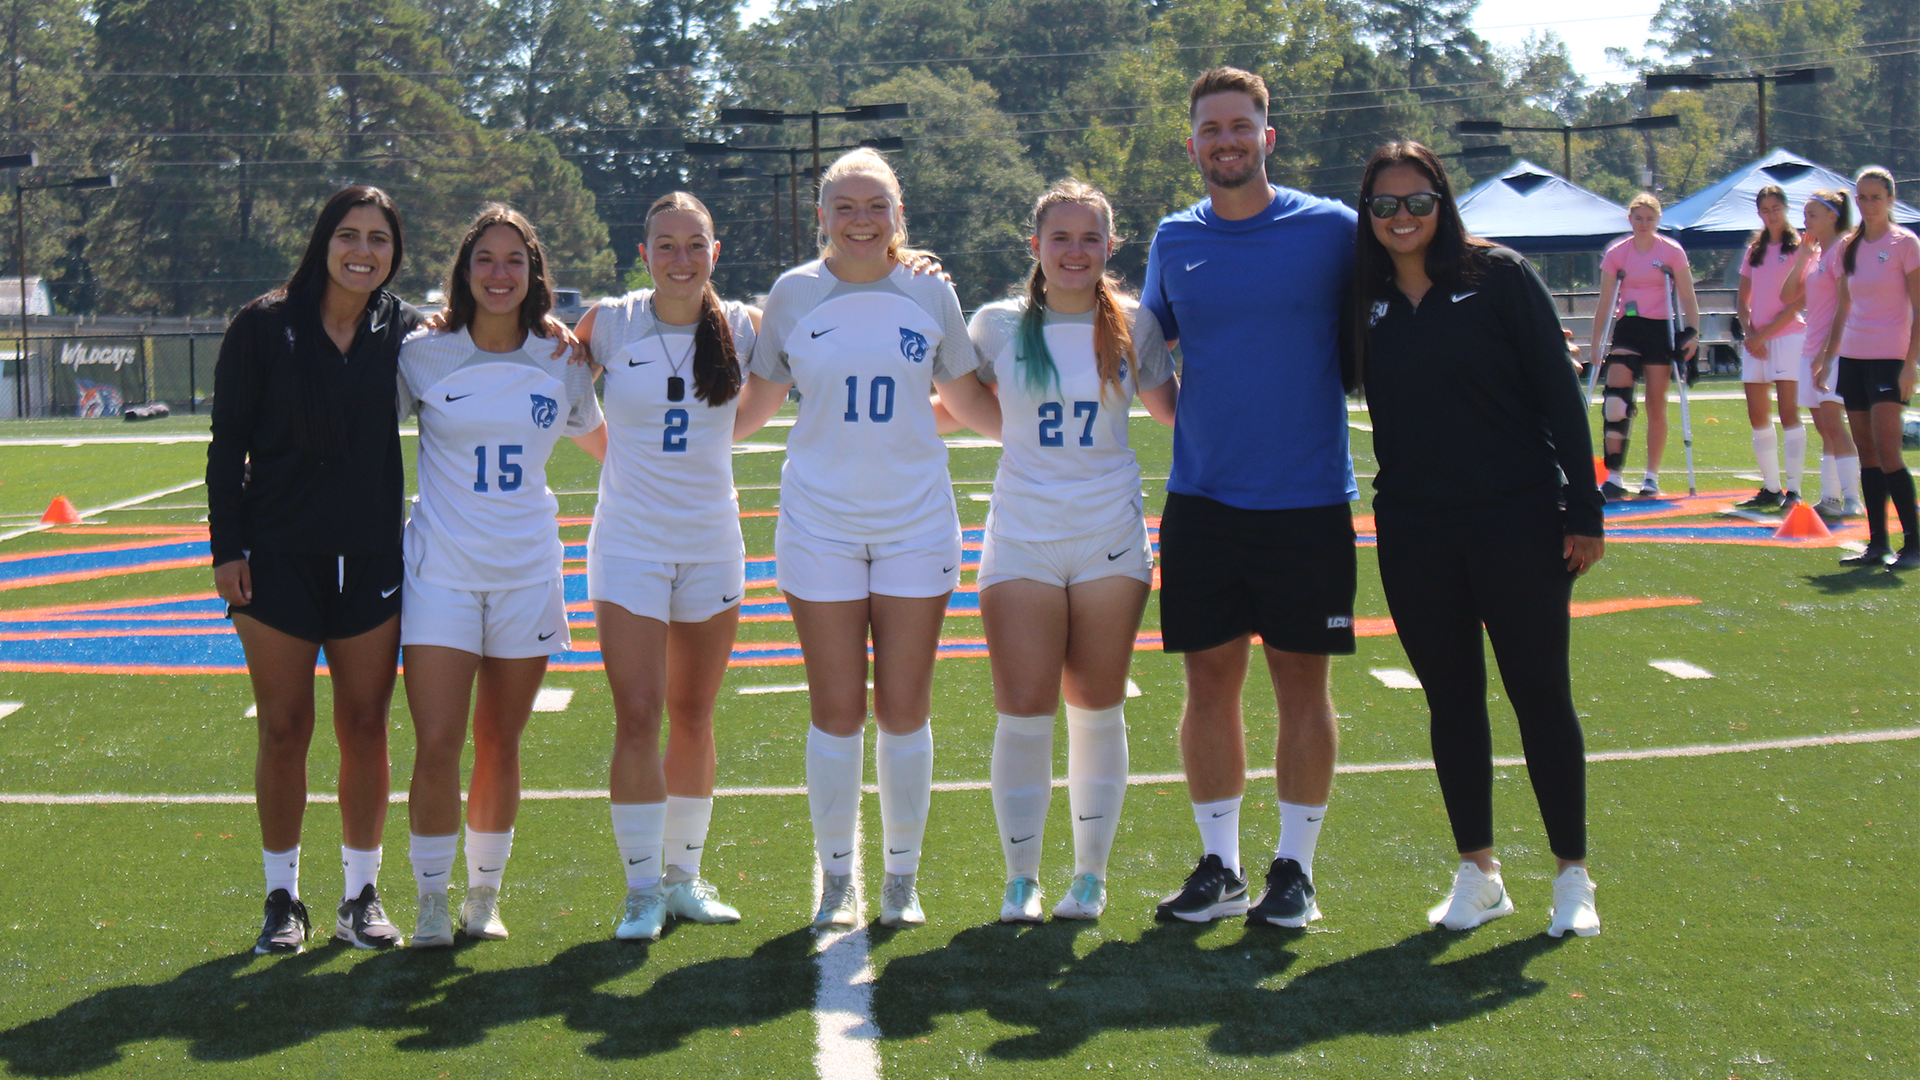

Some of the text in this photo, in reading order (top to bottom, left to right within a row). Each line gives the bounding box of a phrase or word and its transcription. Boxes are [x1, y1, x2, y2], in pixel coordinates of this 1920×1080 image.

[61, 342, 136, 372] WILDCATS
[844, 375, 896, 423] 10
[662, 408, 689, 452] 2
[1037, 401, 1099, 447] 27
[473, 445, 523, 493] 15
